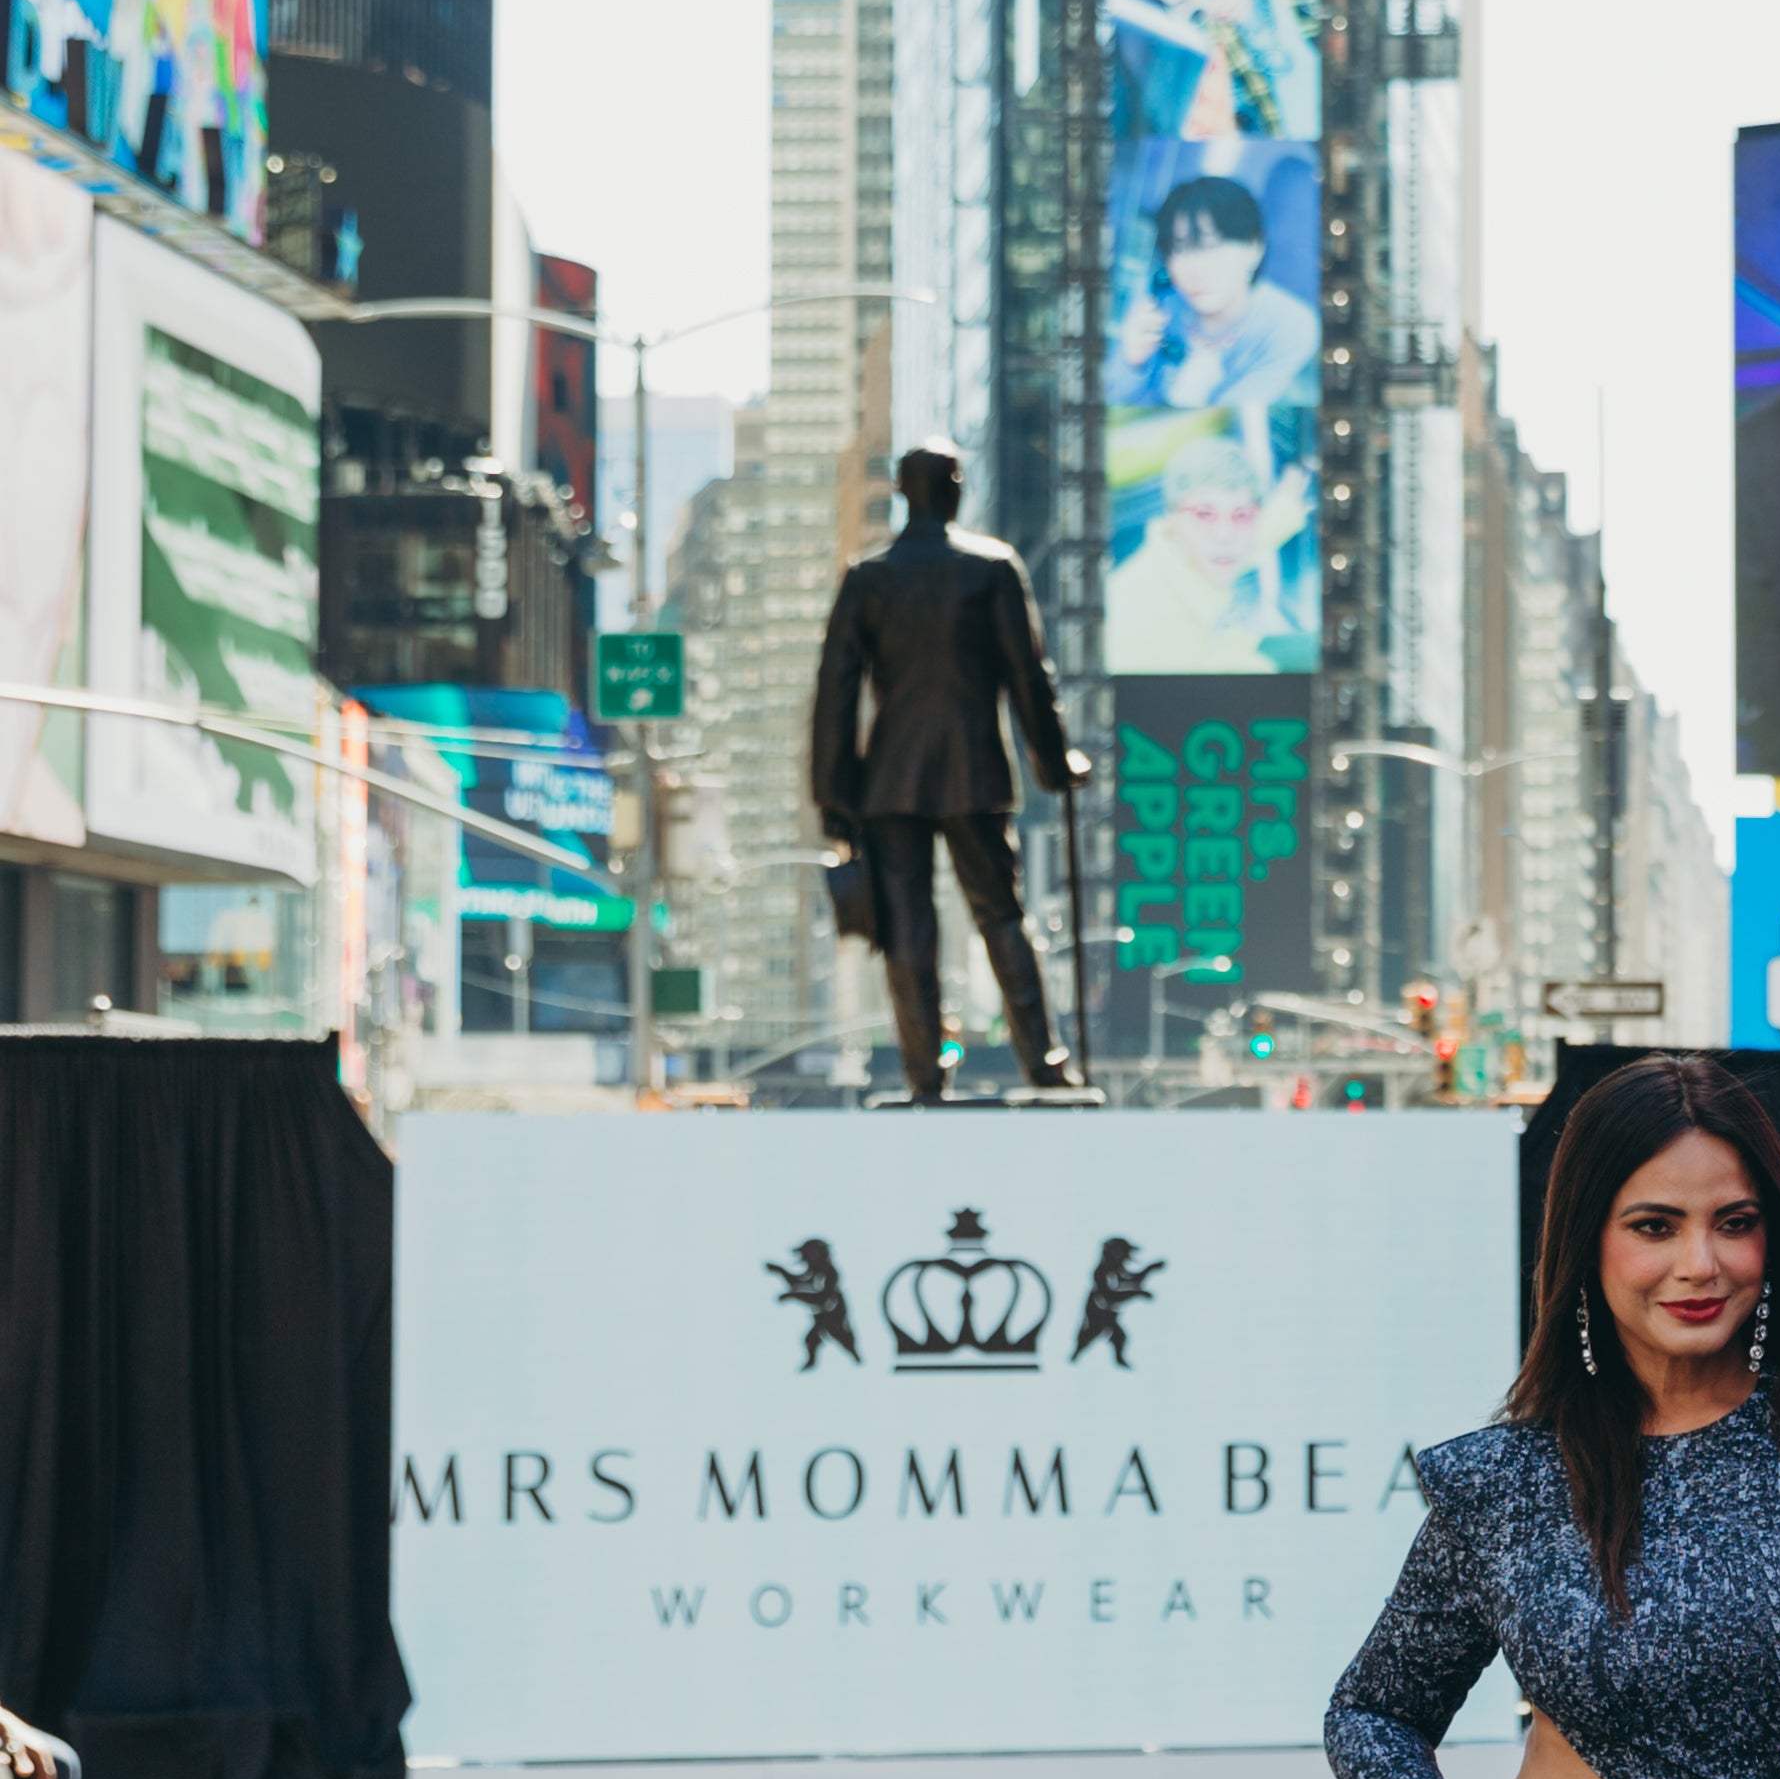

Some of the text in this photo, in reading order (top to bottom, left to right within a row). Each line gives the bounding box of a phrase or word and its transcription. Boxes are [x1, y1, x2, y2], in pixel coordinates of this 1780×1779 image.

[1116, 722, 1180, 972] APPLE
[391, 1439, 1430, 1525] MRS MOMMA BEA
[651, 1576, 1278, 1631] WORKWEAR
